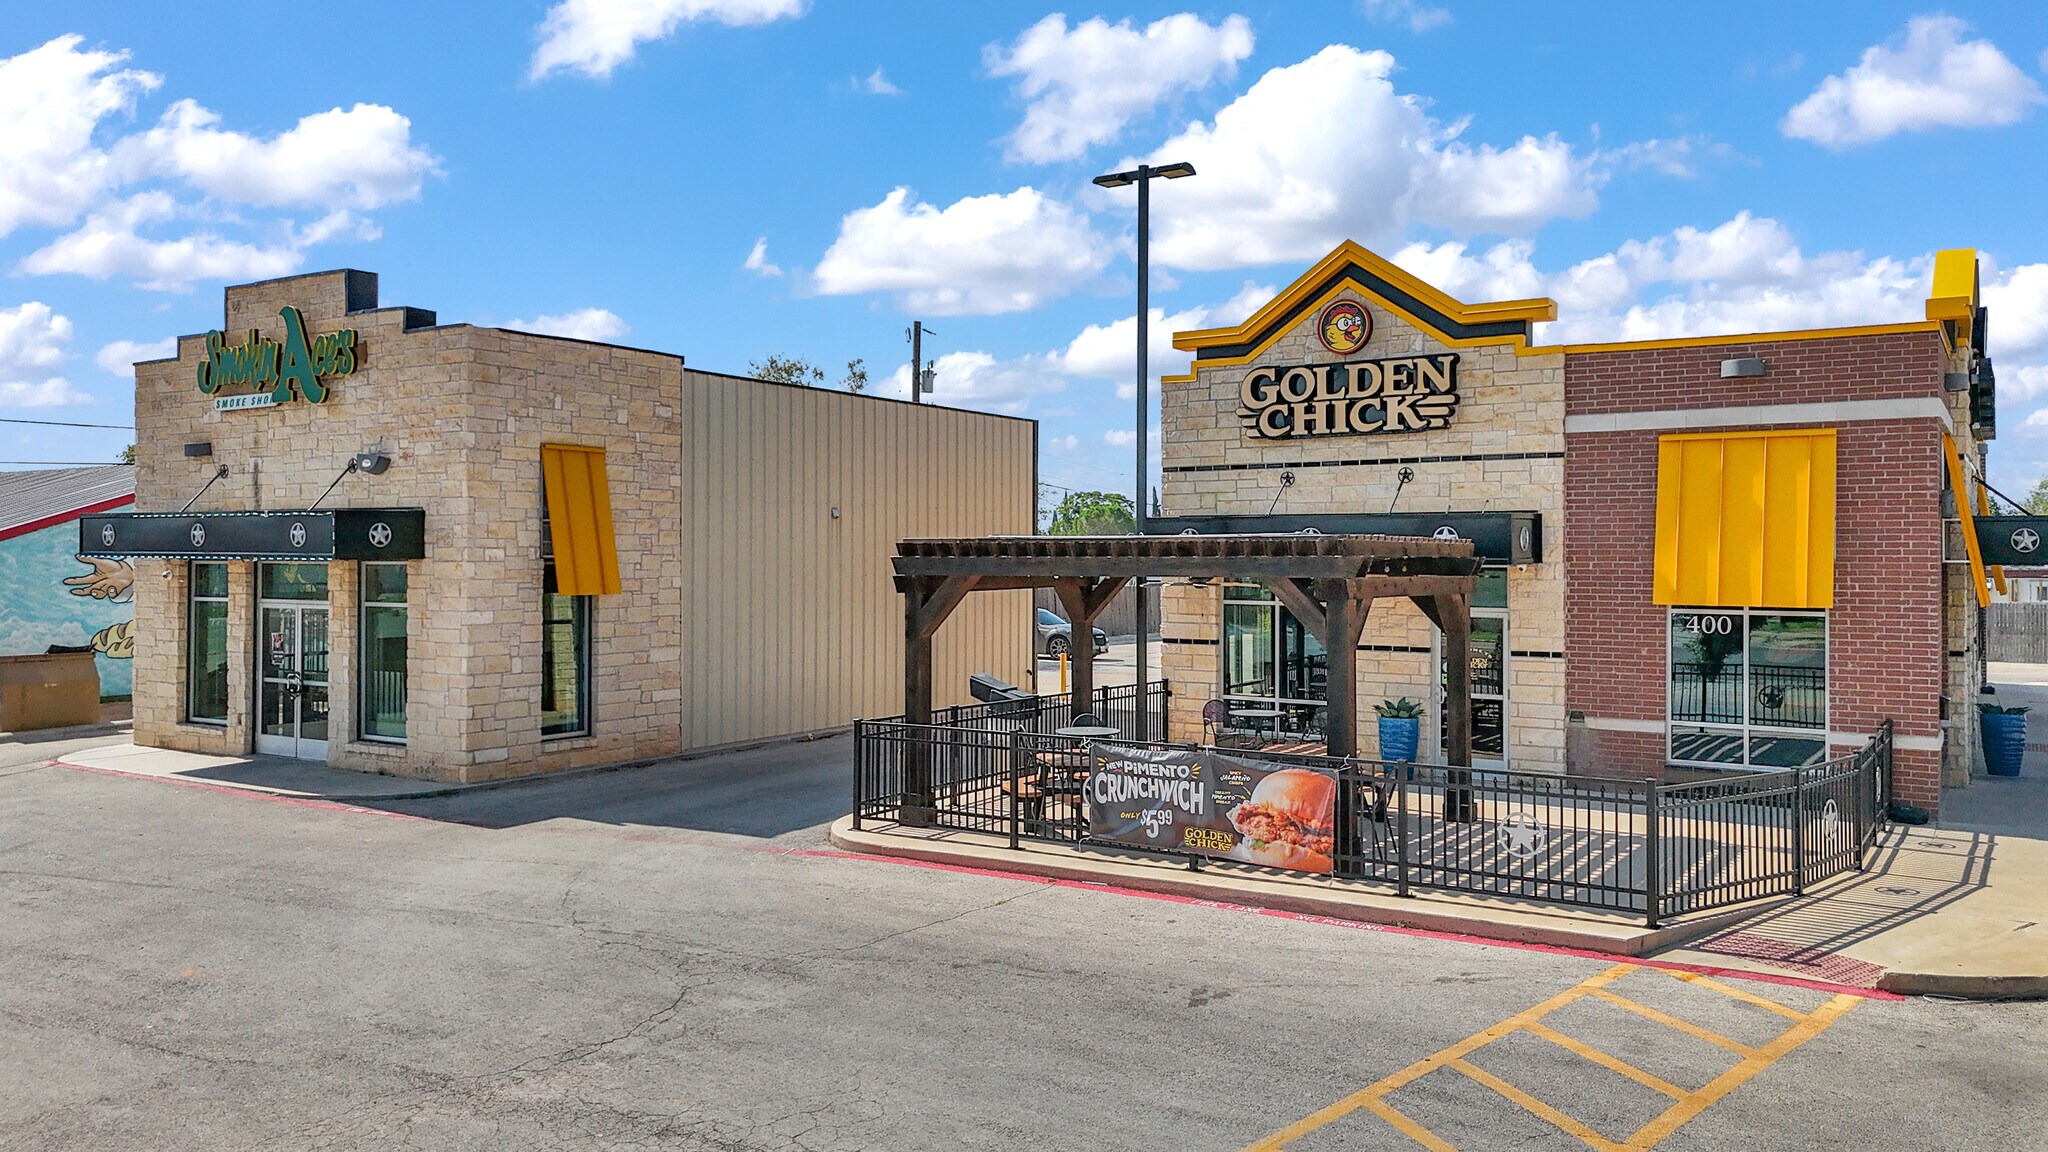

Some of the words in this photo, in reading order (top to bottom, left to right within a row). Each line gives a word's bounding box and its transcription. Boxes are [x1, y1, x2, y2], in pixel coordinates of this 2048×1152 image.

[272, 305, 358, 404] Aces
[1240, 354, 1456, 410] GOLDEN
[216, 397, 247, 409] SMOKE
[1258, 396, 1429, 438] CHICK
[1685, 615, 1732, 635] 400
[1106, 760, 1123, 771] NEW
[1094, 772, 1204, 815] CRUNCHWICH
[1120, 812, 1141, 820] ONLY
[1184, 827, 1232, 843] GOLDEN
[1189, 837, 1227, 851] CHICK
